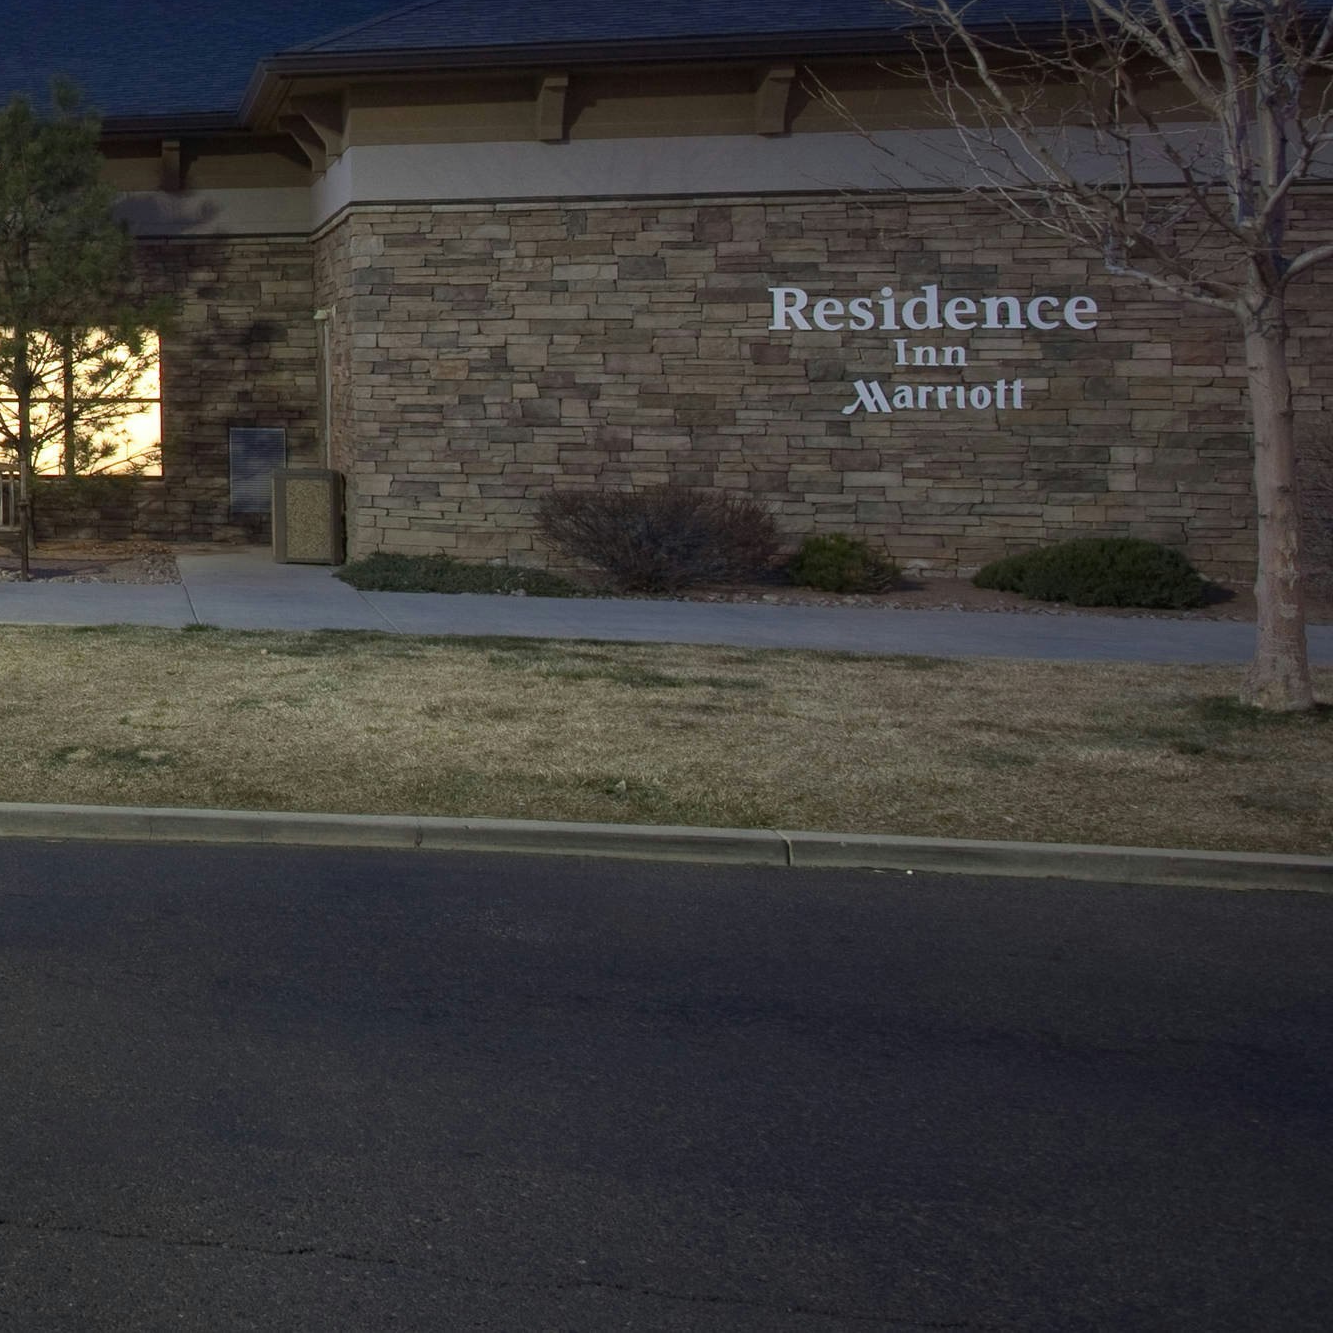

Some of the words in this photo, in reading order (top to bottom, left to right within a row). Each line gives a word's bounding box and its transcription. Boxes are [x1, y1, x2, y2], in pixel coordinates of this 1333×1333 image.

[768, 284, 1098, 331] Residence
[893, 338, 968, 366] Inn
[841, 378, 1025, 414] Marriott
